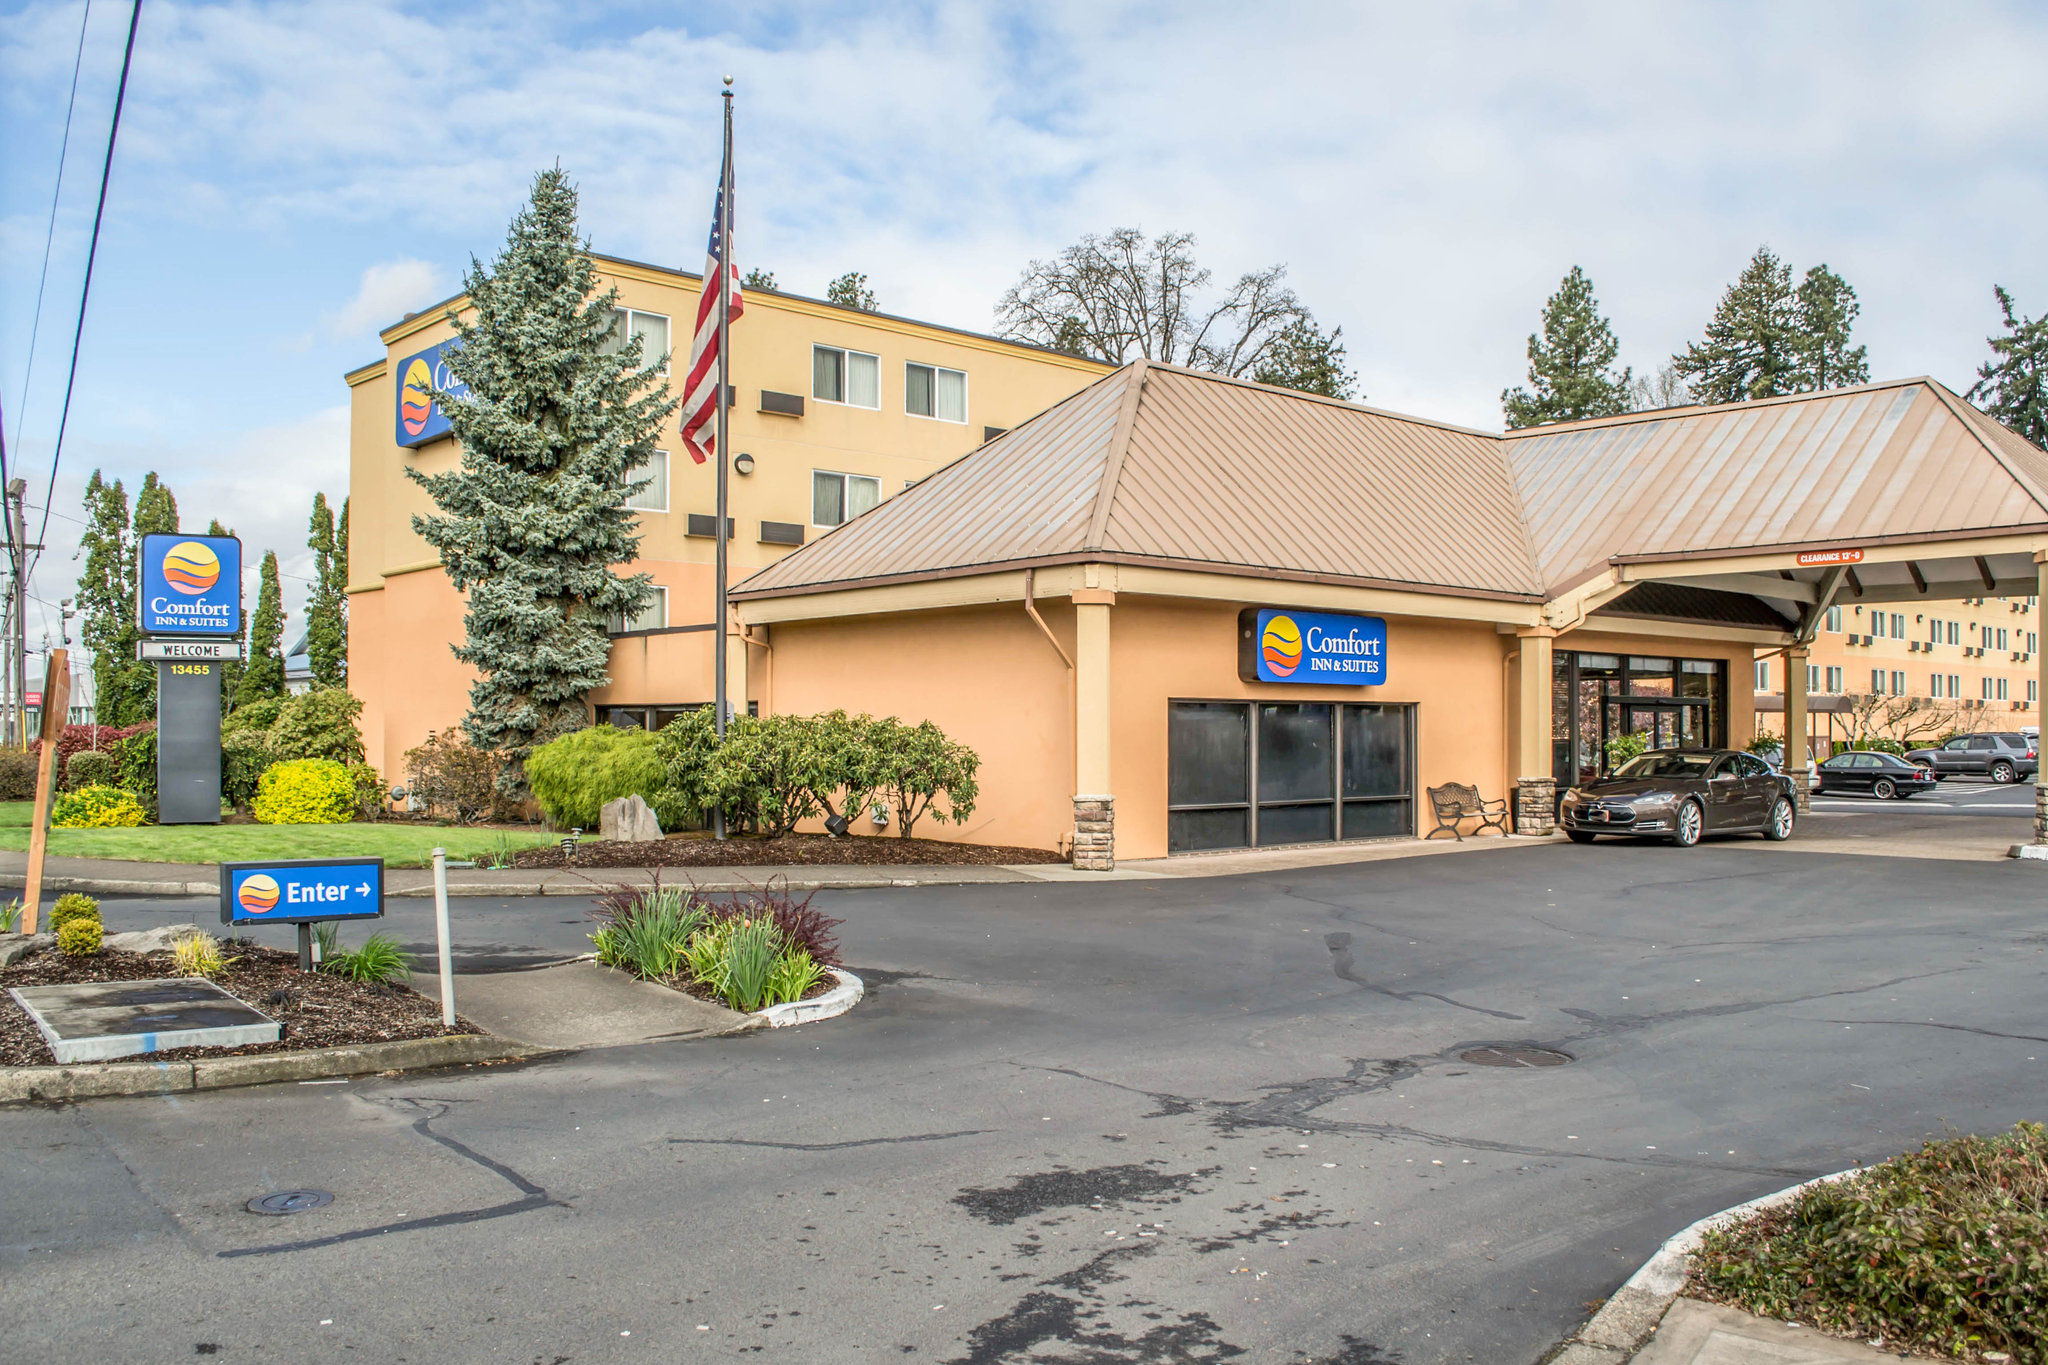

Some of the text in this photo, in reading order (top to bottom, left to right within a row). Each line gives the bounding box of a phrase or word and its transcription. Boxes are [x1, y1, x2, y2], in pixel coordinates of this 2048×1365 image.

[1800, 553, 1840, 563] CLEARANCE
[151, 597, 230, 616] Comfort
[155, 616, 229, 627] INN & SUITES
[1307, 626, 1380, 656] Comfort
[163, 645, 220, 656] WELCOME
[171, 665, 210, 675] 13455
[1311, 658, 1379, 673] INN & SUITES
[287, 882, 350, 903] Enter
